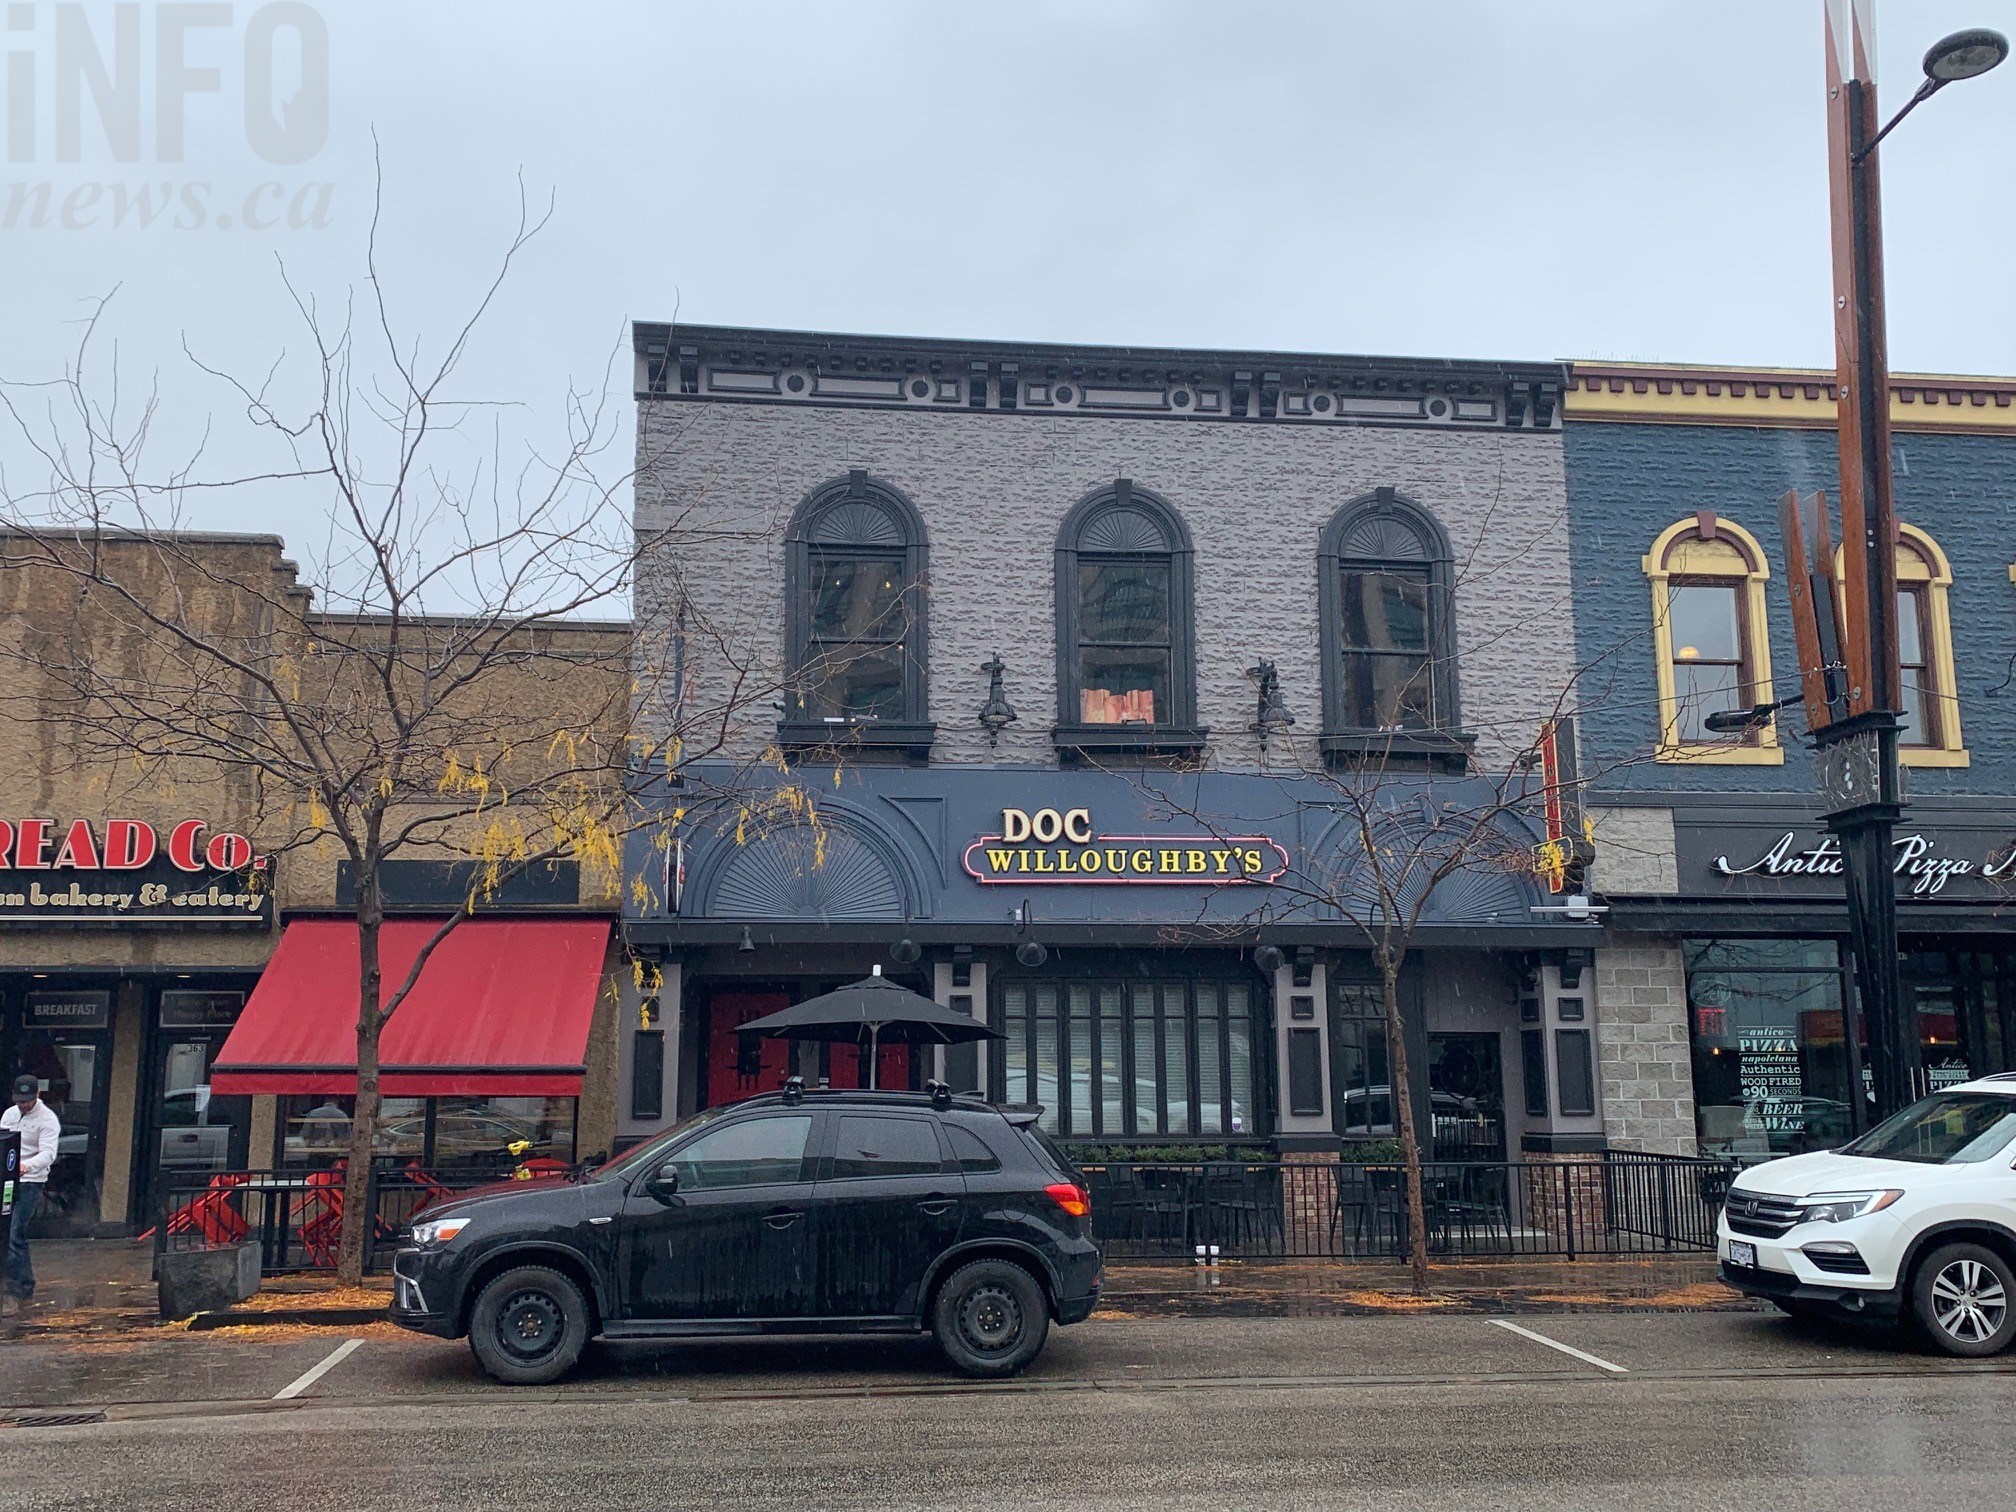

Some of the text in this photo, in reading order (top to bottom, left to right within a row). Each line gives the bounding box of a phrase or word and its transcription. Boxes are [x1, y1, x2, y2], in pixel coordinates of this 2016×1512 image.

[1001, 807, 1093, 844] DOC
[169, 819, 267, 872] Co.
[986, 847, 1263, 873] WILLOUGHBY'S
[1891, 834, 1975, 894] Pizza
[30, 882, 134, 912] bakery
[139, 882, 168, 906] &
[172, 886, 264, 911] eatery
[34, 1004, 98, 1016] BREAKFAST
[1749, 1027, 1784, 1036] antico
[188, 1044, 204, 1053] 363
[1740, 1039, 1799, 1052] PIZZA
[1740, 1064, 1801, 1074] Authentic
[1740, 1077, 1802, 1086] WOOD FIRED
[1750, 1085, 1768, 1098] 90
[1762, 1103, 1803, 1115] BEER
